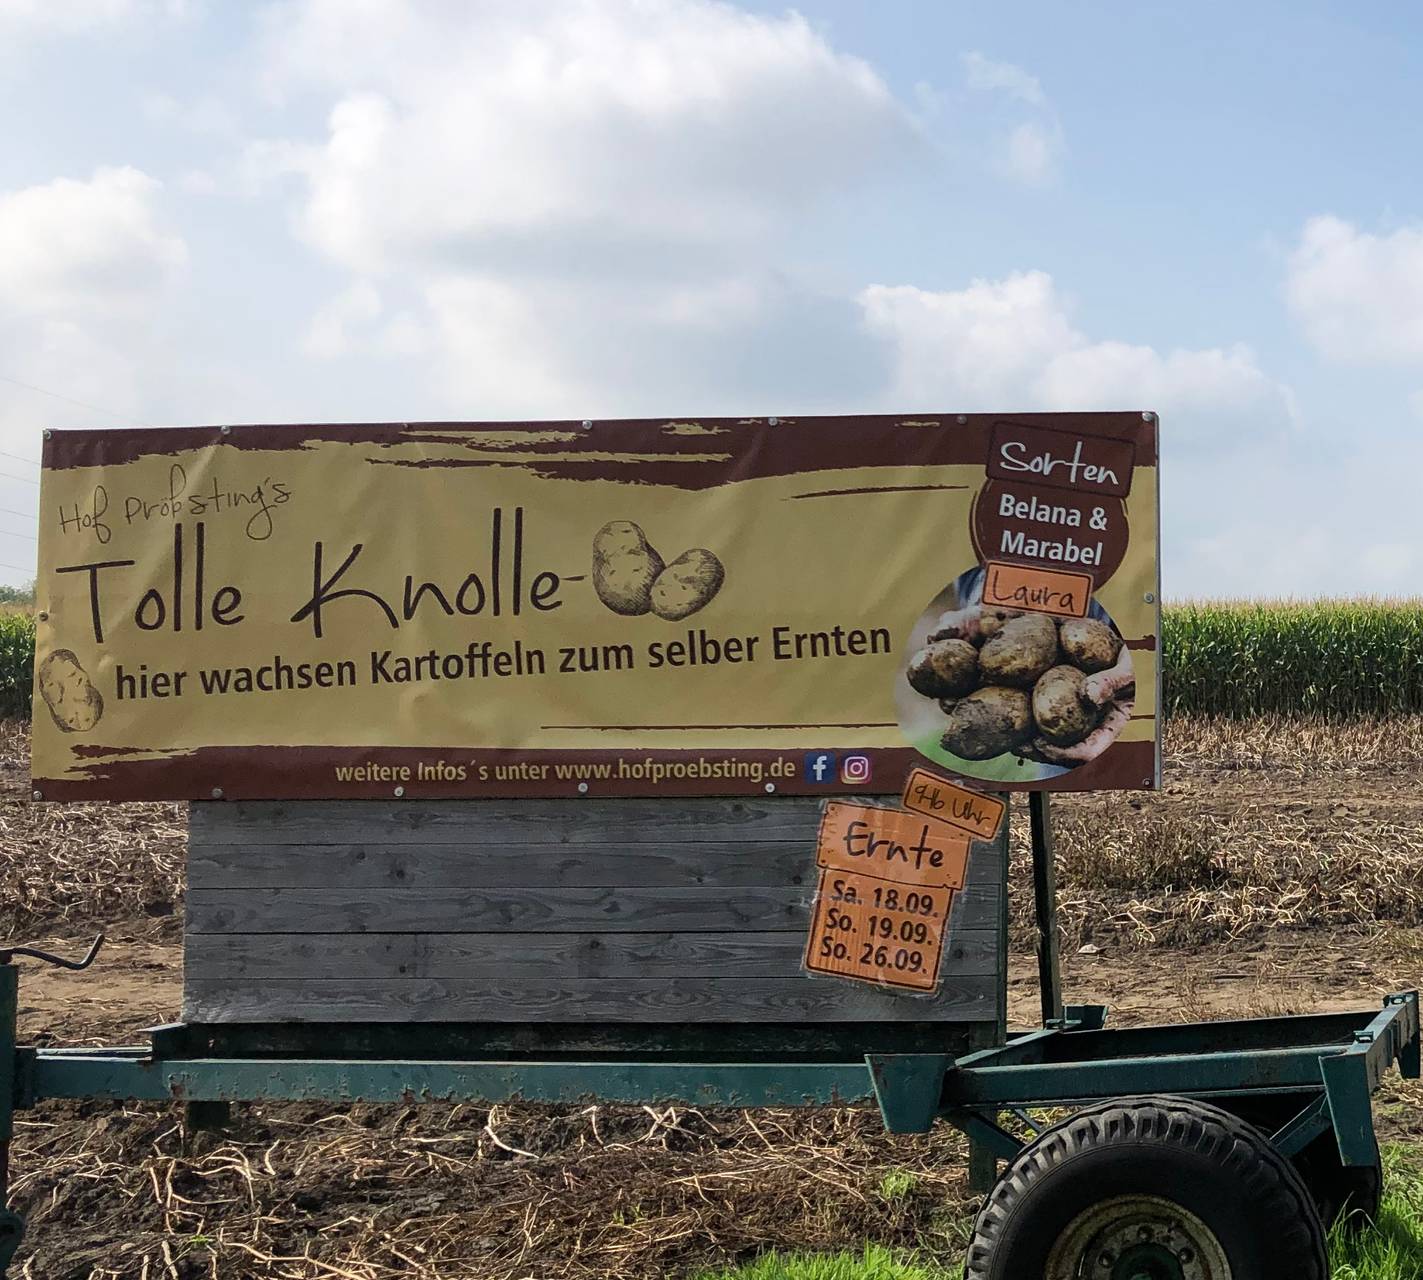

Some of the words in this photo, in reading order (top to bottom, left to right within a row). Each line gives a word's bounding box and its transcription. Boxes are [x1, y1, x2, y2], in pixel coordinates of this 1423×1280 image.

[1000, 441, 1119, 485] Sorten
[58, 484, 112, 545] Hof
[1000, 494, 1081, 527] Belana
[1089, 507, 1108, 530] &
[1001, 530, 1103, 565] Marabel
[55, 521, 246, 644] Tolle
[992, 570, 1075, 613] Laura
[115, 663, 187, 699] hier
[200, 656, 356, 695] wachsen
[371, 640, 546, 683] Kartoffeln
[558, 643, 634, 673] zum
[648, 628, 760, 667] selber
[773, 624, 892, 660] Ernten
[335, 762, 411, 782] weitere
[495, 762, 549, 780] unter
[554, 757, 796, 783] www.hofproebsting.de
[952, 798, 992, 826] Uhr
[843, 821, 944, 870] Ernte
[832, 879, 863, 906] Sa.
[873, 887, 939, 918] 18.09.
[825, 907, 857, 934] So.
[868, 915, 933, 946] 19.09.
[820, 936, 852, 962] So.
[859, 943, 928, 975] 26.09.
